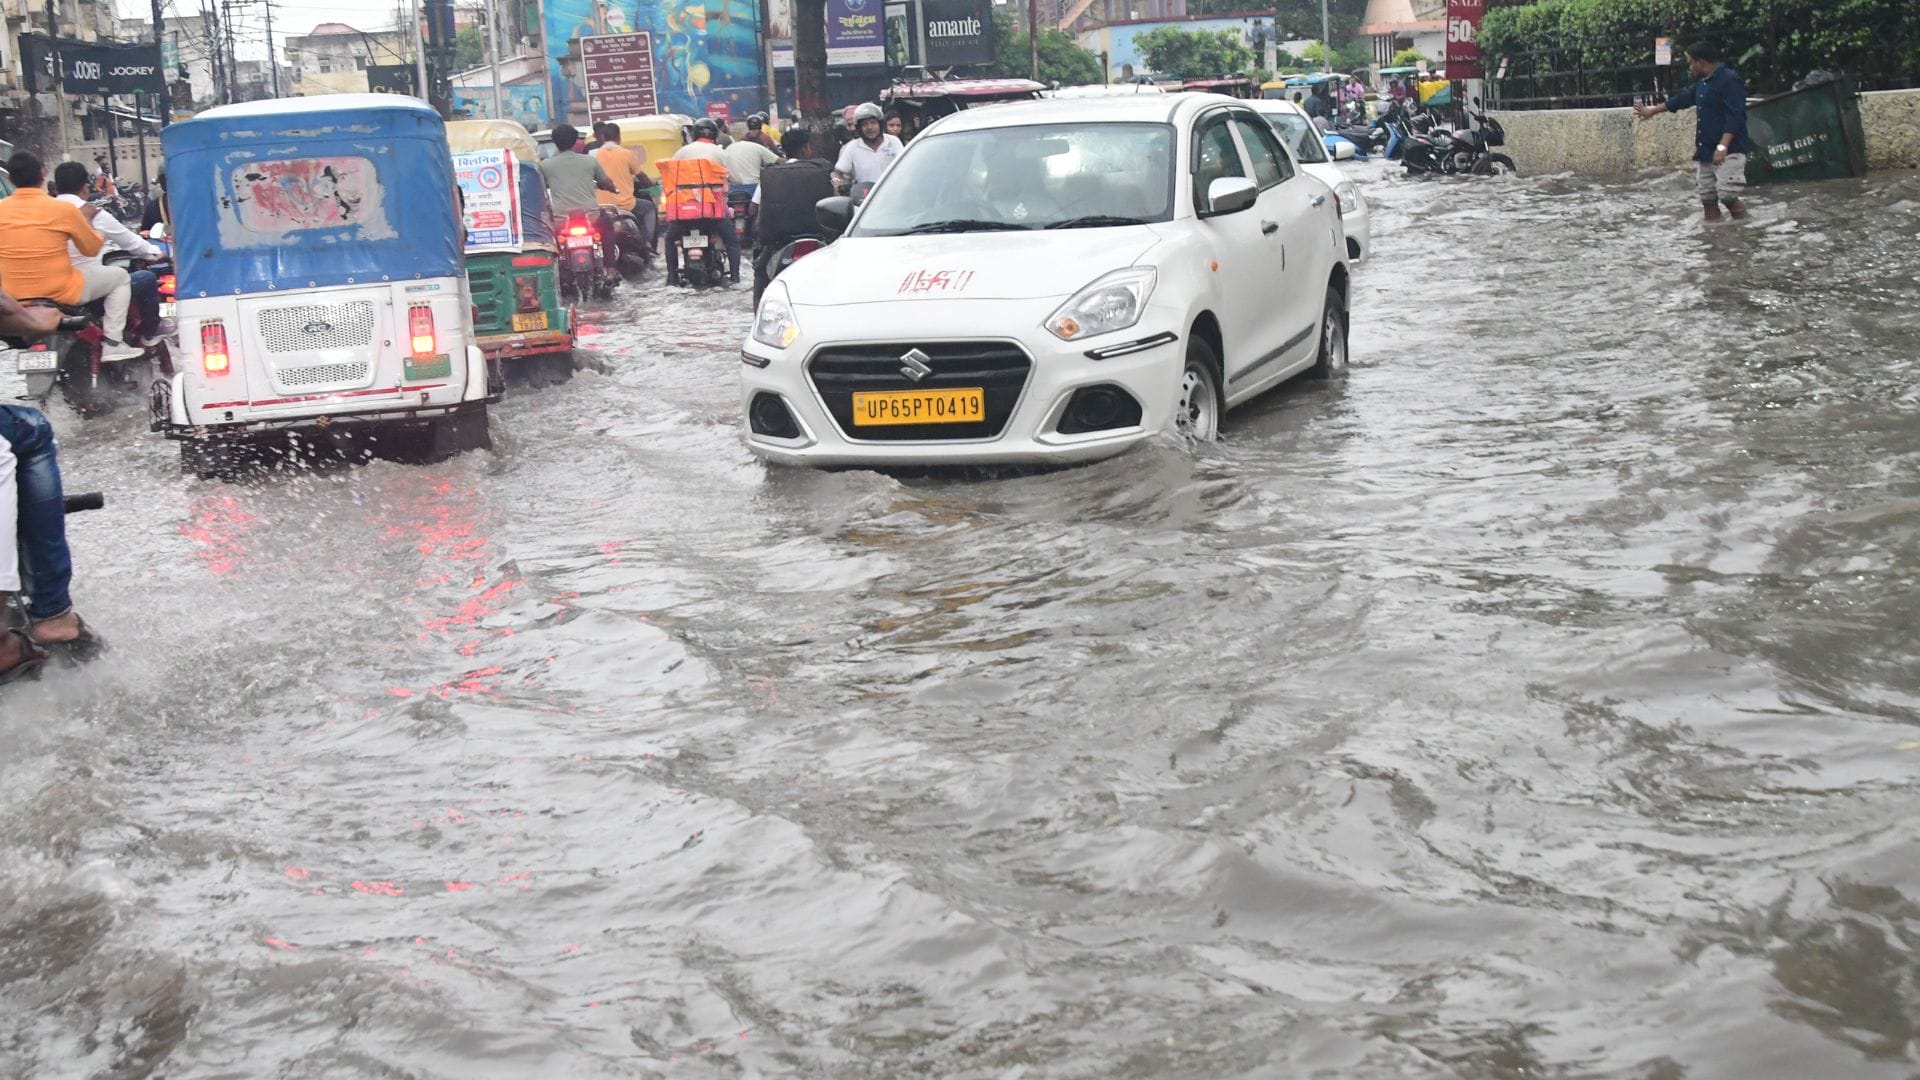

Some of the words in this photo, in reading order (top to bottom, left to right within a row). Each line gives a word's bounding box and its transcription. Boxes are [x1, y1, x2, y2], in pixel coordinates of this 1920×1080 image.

[929, 16, 981, 37] amante
[109, 66, 155, 76] JOCKEY
[868, 396, 979, 419] UP65PT0419
